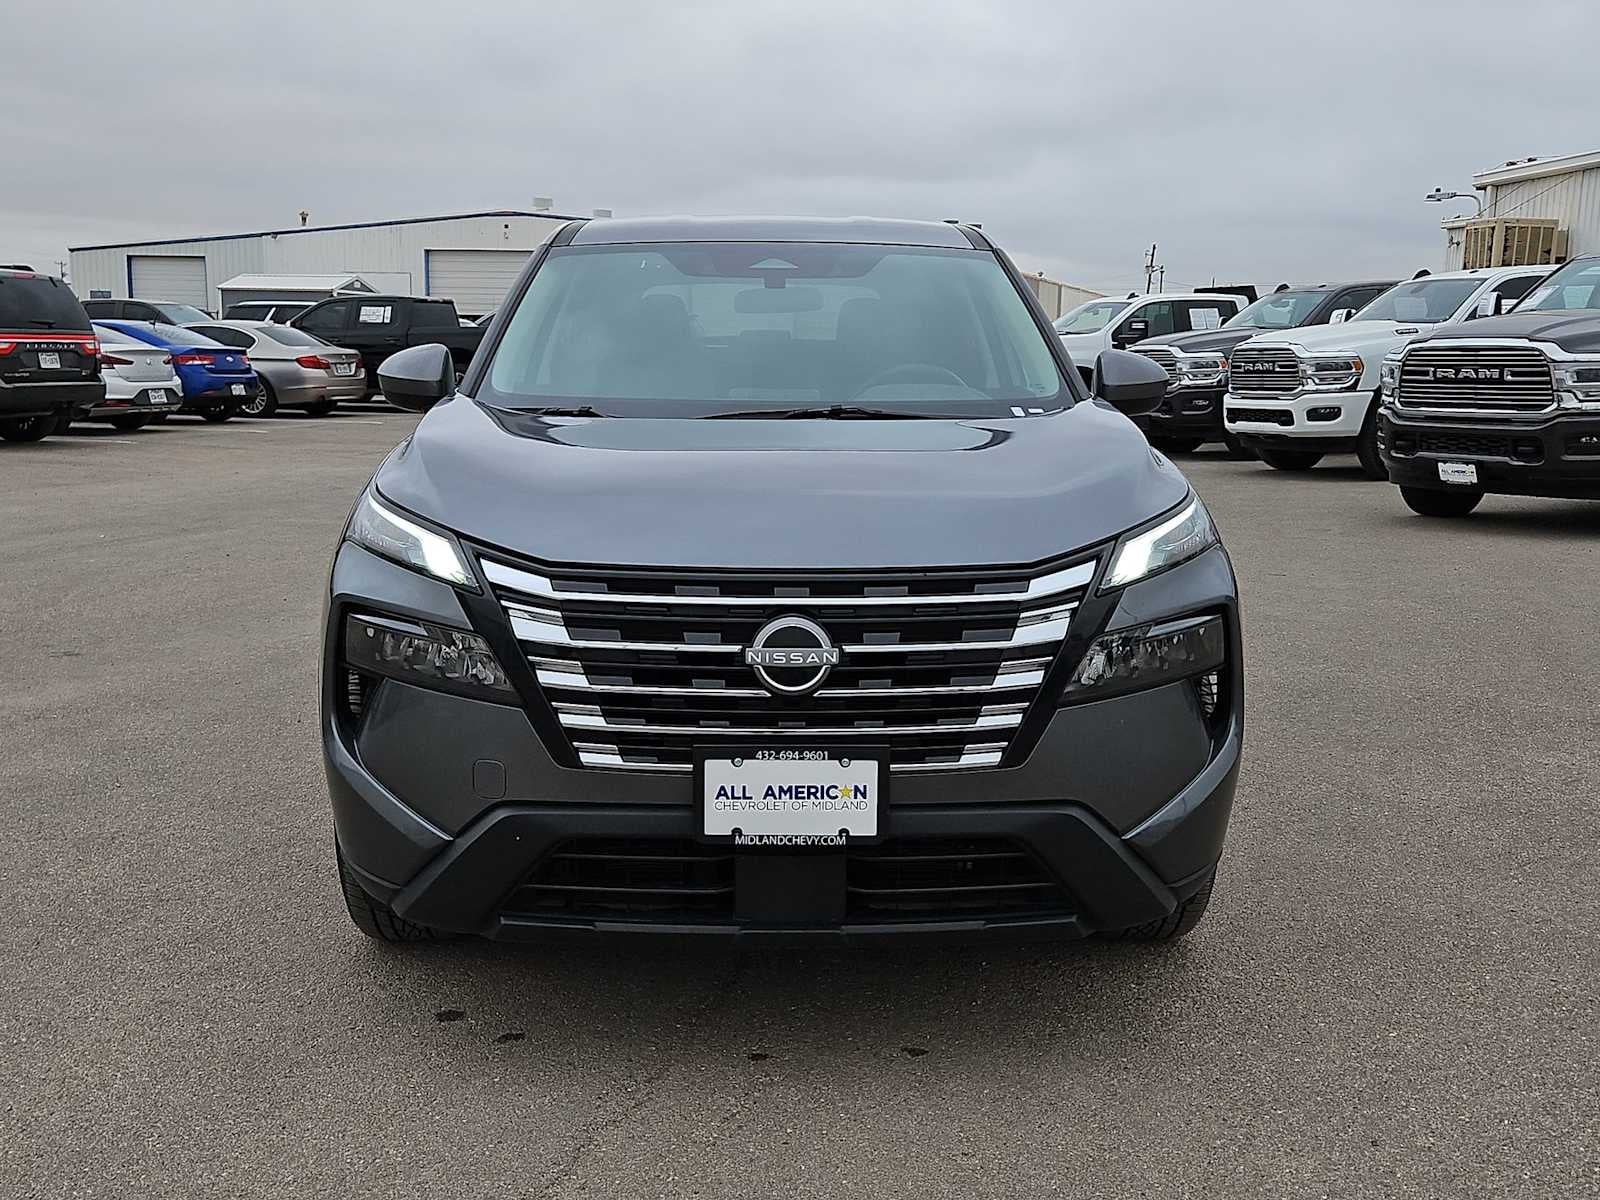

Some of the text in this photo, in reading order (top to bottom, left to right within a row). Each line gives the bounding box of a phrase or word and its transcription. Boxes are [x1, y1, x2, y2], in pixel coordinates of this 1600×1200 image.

[1244, 363, 1273, 371] RAM
[1436, 368, 1500, 379] RAM
[748, 651, 838, 664] NISSAN
[755, 751, 829, 761] 432-694-9601
[715, 784, 868, 800] ALL AMERICN
[714, 801, 868, 811] CHEVROLET OF MIDLAND
[734, 835, 846, 846] MIDLANDCHEVY.COM
